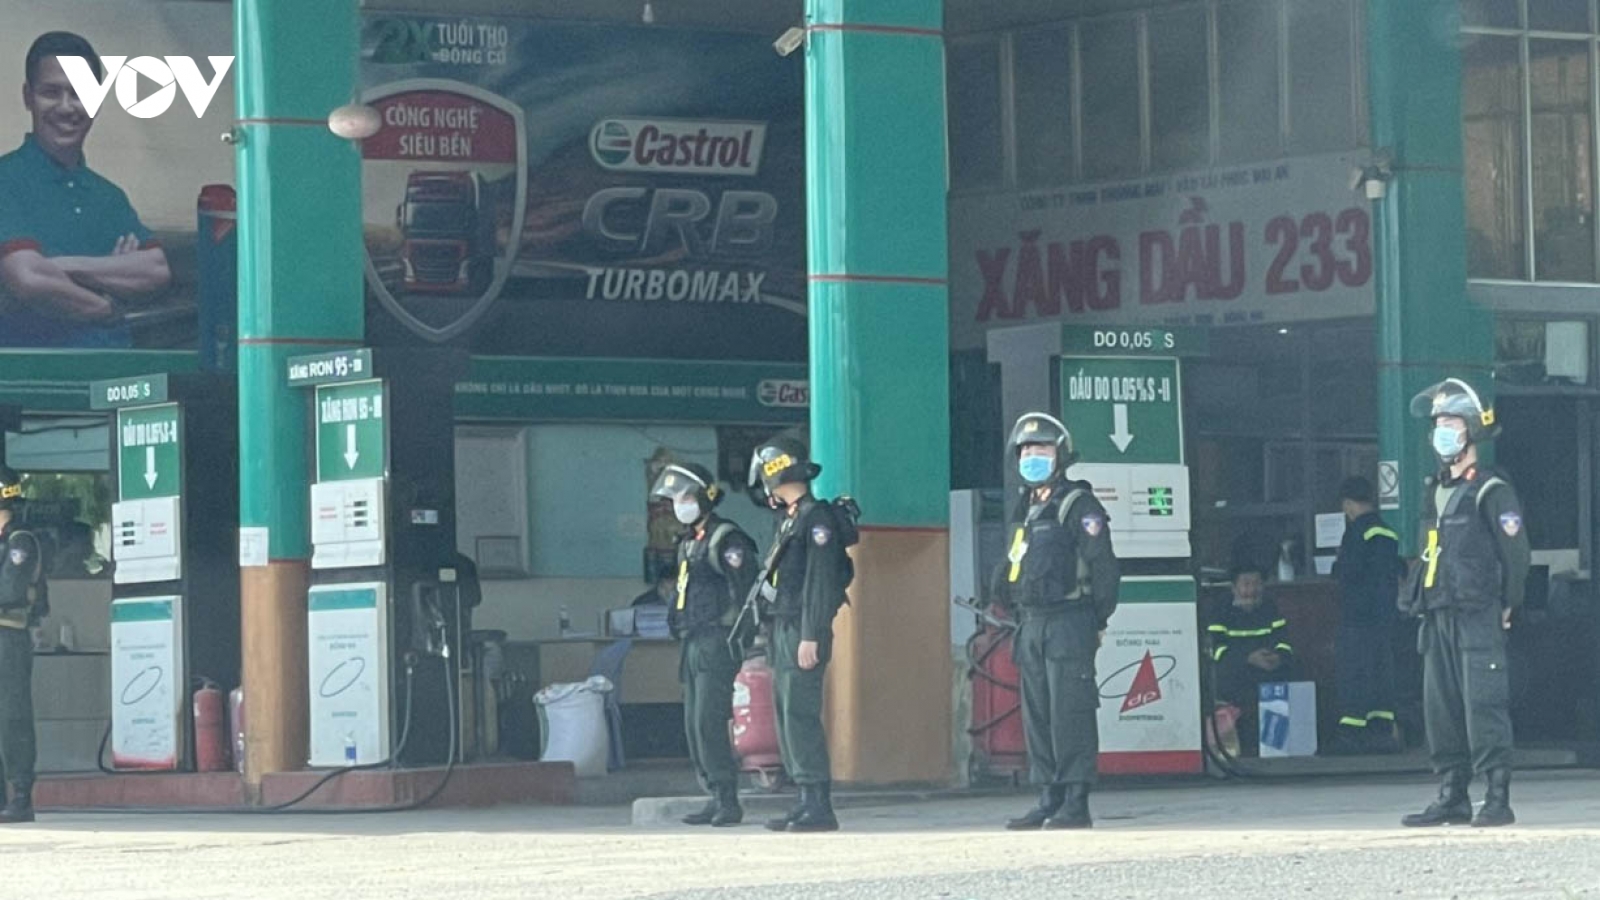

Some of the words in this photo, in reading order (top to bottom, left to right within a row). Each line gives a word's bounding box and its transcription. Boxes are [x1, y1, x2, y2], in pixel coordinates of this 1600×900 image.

[386, 102, 430, 127] CÔNG
[434, 105, 480, 134] NGHỆ
[399, 132, 435, 157] SIÊU
[634, 124, 753, 168] Castrol
[582, 186, 778, 252] CRB
[975, 228, 1121, 322] XĂNG
[1139, 196, 1246, 306] DẦU
[1264, 206, 1372, 296] 233
[586, 268, 766, 304] TURBOMAX
[1093, 331, 1116, 348] DO
[1120, 331, 1152, 350] 0,05
[1163, 332, 1175, 348] S
[309, 359, 333, 377] RON
[334, 356, 348, 377] 95
[106, 386, 121, 402] DO
[1094, 376, 1110, 401] DO
